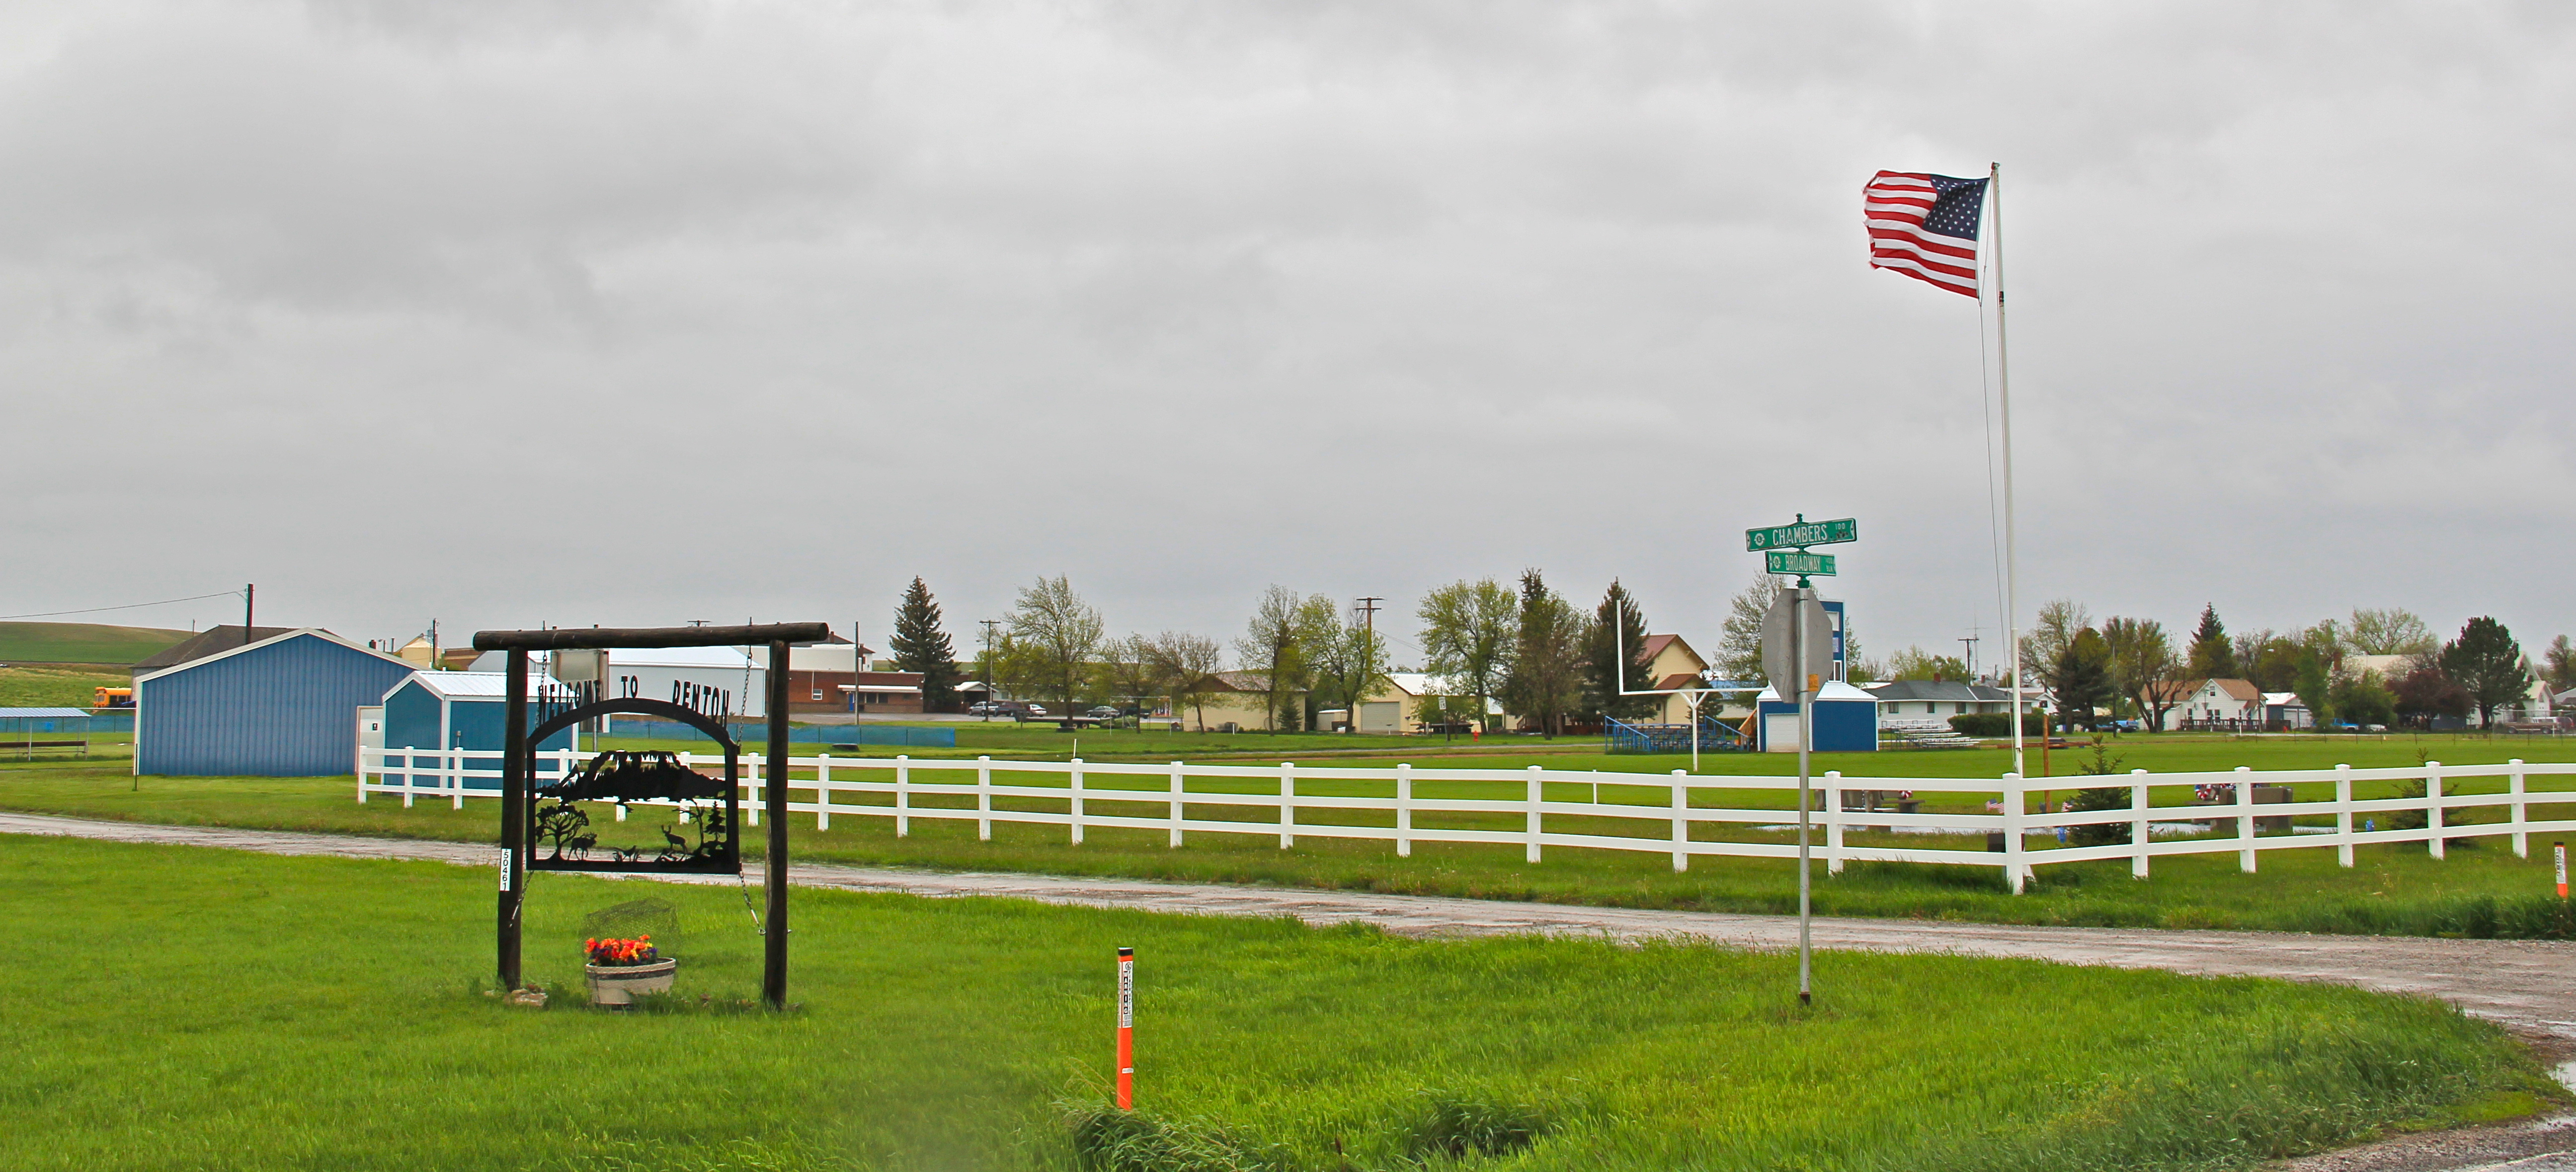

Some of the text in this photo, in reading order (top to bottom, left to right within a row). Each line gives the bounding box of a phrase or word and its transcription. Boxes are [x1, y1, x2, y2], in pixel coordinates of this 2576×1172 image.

[1772, 524, 1828, 546] CHAMBERS
[1785, 554, 1821, 572] BROADWAY
[538, 675, 729, 730] WELCOME TO DENTON
